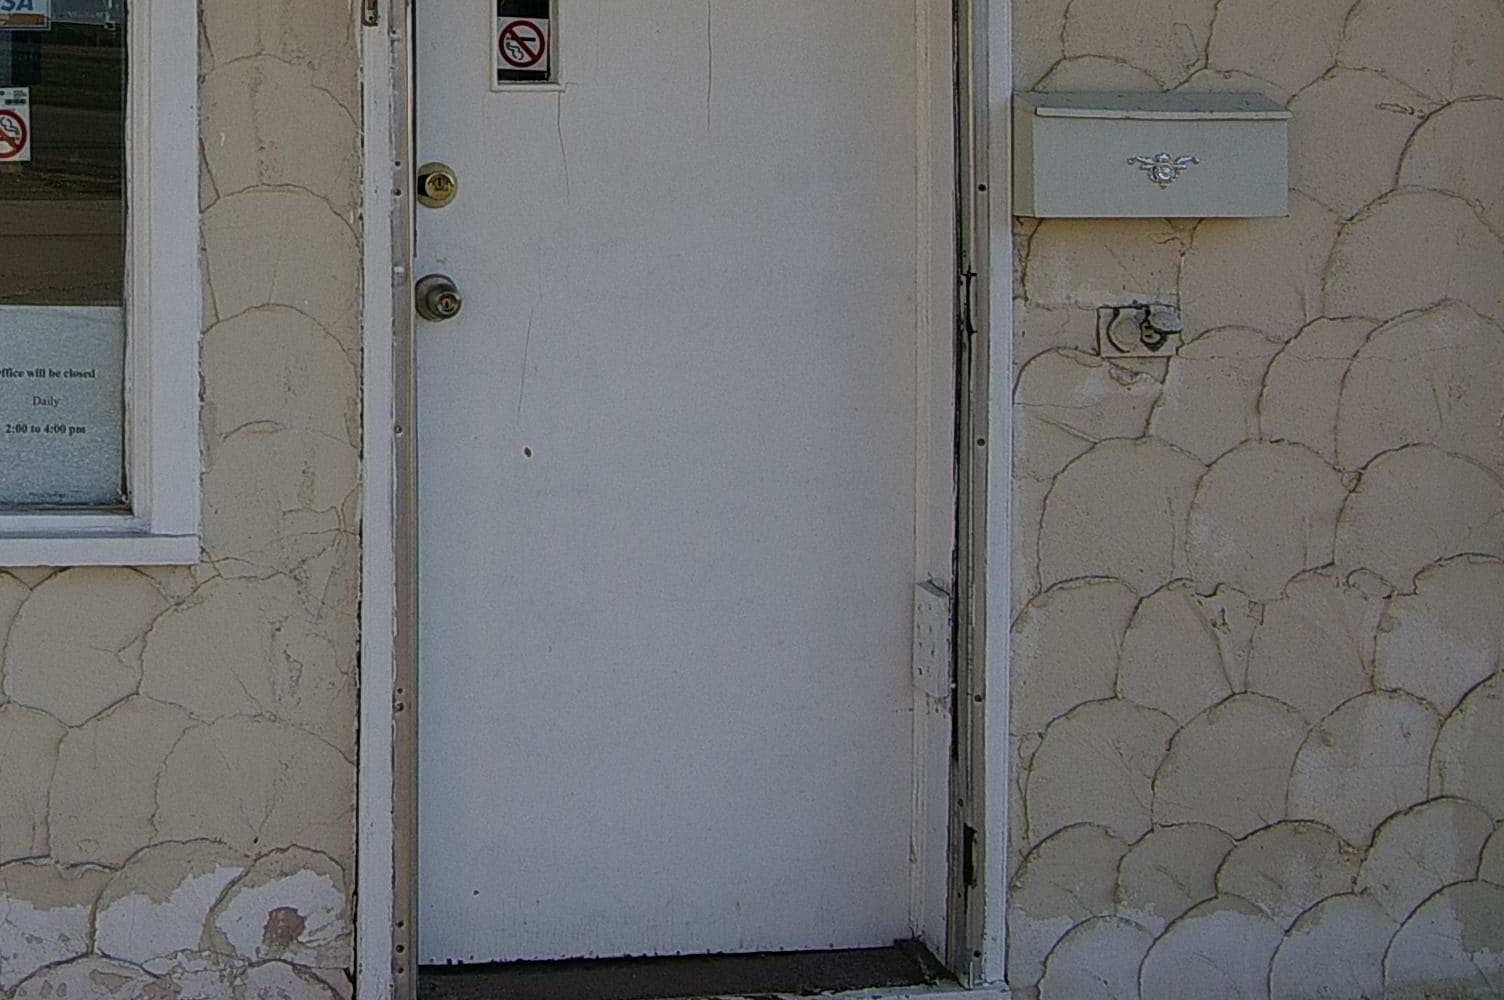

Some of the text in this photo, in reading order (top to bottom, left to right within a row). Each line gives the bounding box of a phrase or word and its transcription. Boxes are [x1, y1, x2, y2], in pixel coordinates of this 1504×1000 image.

[26, 367, 46, 378] will
[48, 367, 62, 378] be
[63, 367, 96, 378] closed
[32, 395, 61, 408] Daily
[5, 423, 86, 436] 2:00 to 4:00 pm
